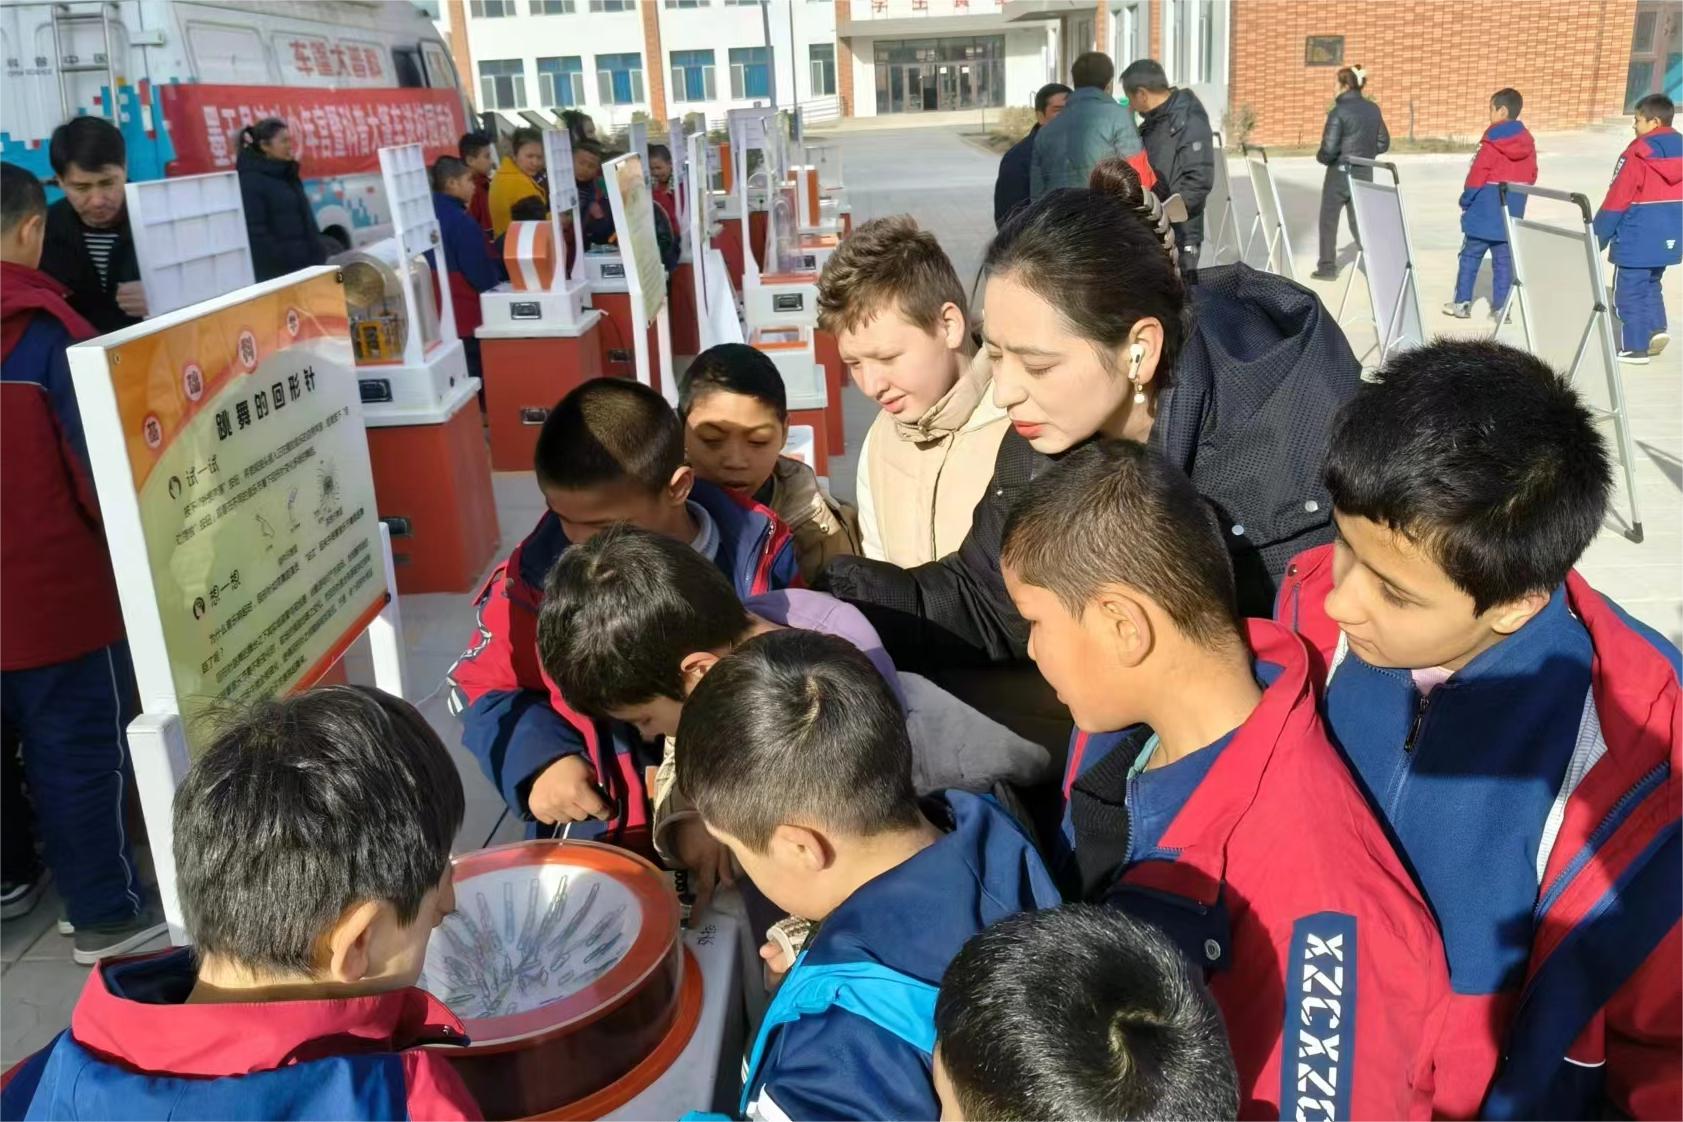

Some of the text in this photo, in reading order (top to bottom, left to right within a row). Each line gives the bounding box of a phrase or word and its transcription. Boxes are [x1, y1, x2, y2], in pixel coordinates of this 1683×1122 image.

[215, 365, 316, 441] 跳舞的回形针
[184, 454, 220, 488] 试一试
[209, 568, 241, 609] 想一想
